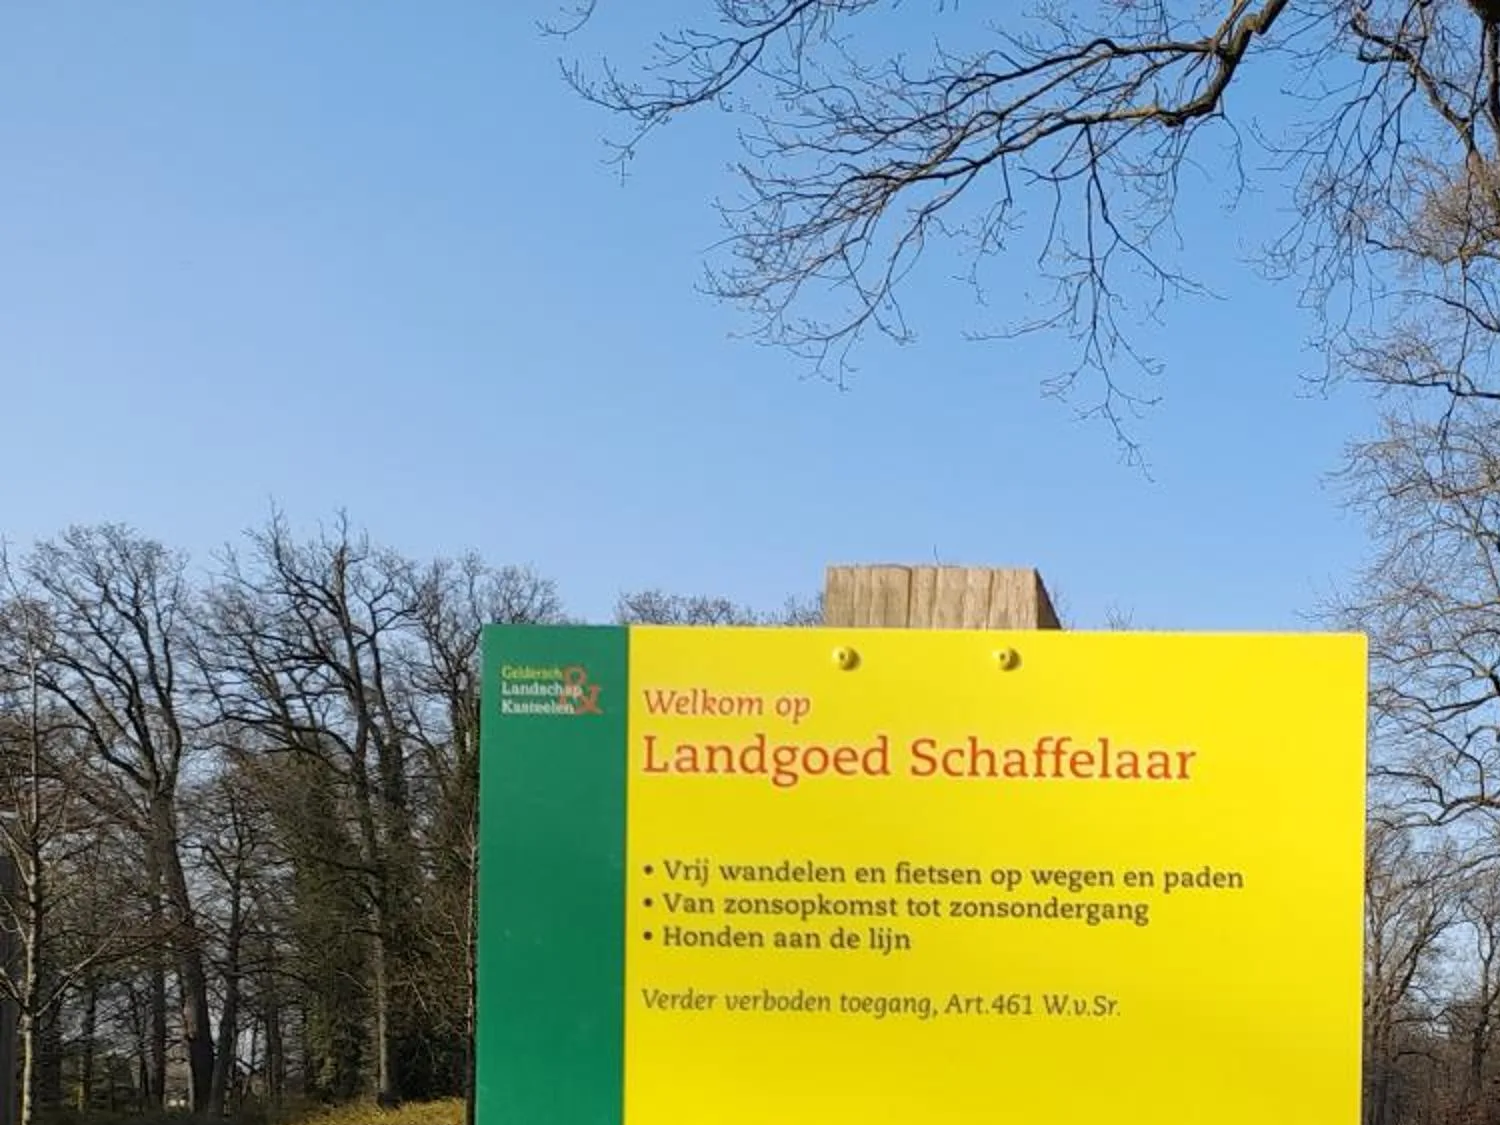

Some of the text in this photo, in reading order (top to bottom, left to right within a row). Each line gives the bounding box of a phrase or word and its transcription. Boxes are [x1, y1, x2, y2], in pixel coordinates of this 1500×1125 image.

[502, 681, 582, 698] Landschap
[502, 699, 575, 714] Kasteelen
[643, 688, 811, 724] Welkom op
[643, 732, 1196, 787] Landgoed Schaffelaar
[664, 859, 1244, 893] Vrij wandelen en fietsen op wegen en paden
[663, 893, 1149, 925] Van zonsopkomst tot zonsondergang
[663, 926, 912, 954] Honden aan de lijn
[642, 989, 716, 1010] Verder
[723, 990, 832, 1011] verboden
[839, 993, 939, 1020] toegang,
[945, 994, 1031, 1014] Art.461
